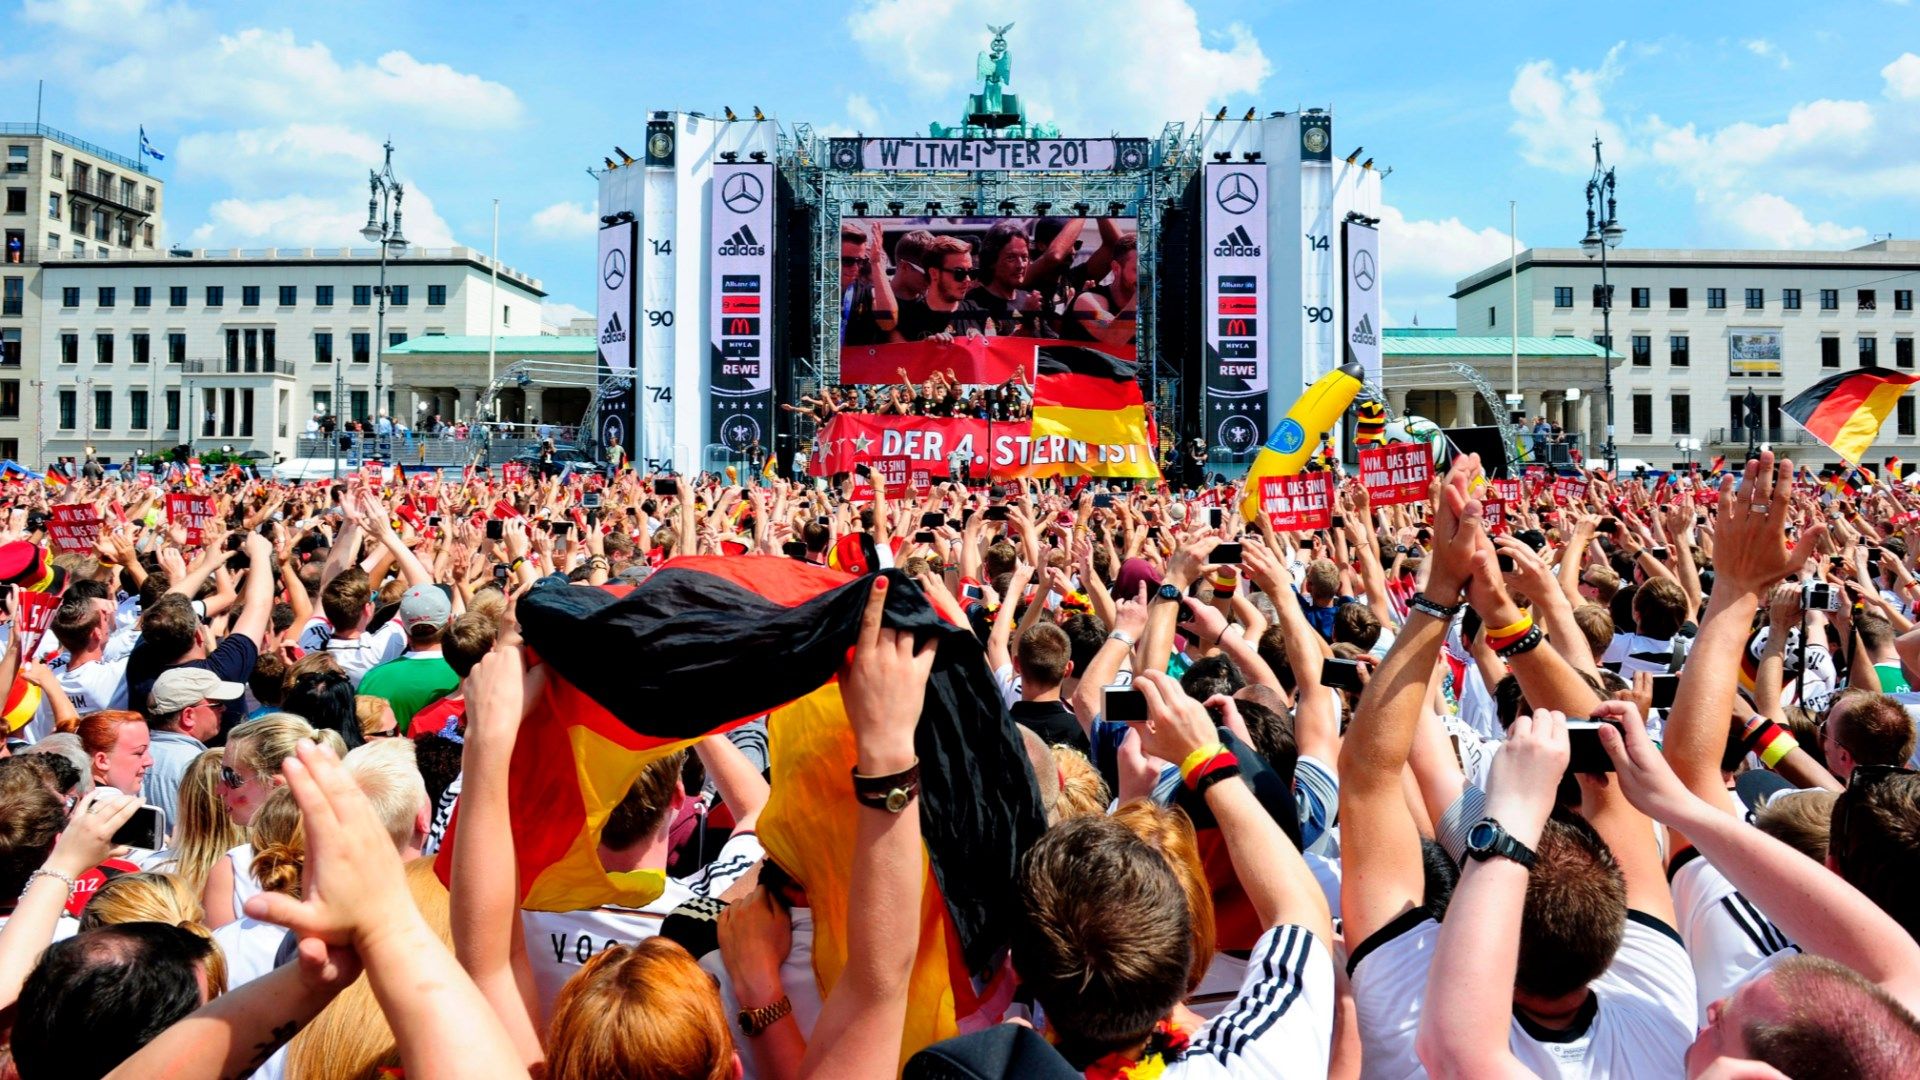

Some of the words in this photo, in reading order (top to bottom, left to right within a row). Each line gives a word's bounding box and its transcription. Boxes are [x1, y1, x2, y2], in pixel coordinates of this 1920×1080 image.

[718, 245, 765, 256] adidas
[1214, 245, 1261, 257] adidas
[722, 364, 759, 375] REWE
[1219, 365, 1256, 376] REWE
[881, 428, 944, 461] DER
[994, 434, 1088, 466] STERN
[1363, 456, 1384, 471] WM.
[1386, 453, 1405, 469] DAS
[1406, 450, 1427, 467] SIND
[1363, 471, 1390, 488] WIR
[1391, 465, 1428, 486] ALLE!
[1287, 480, 1304, 496] DAS
[1305, 478, 1326, 494] SIND
[1265, 497, 1292, 513] WIR
[1292, 494, 1328, 512] ALLE!
